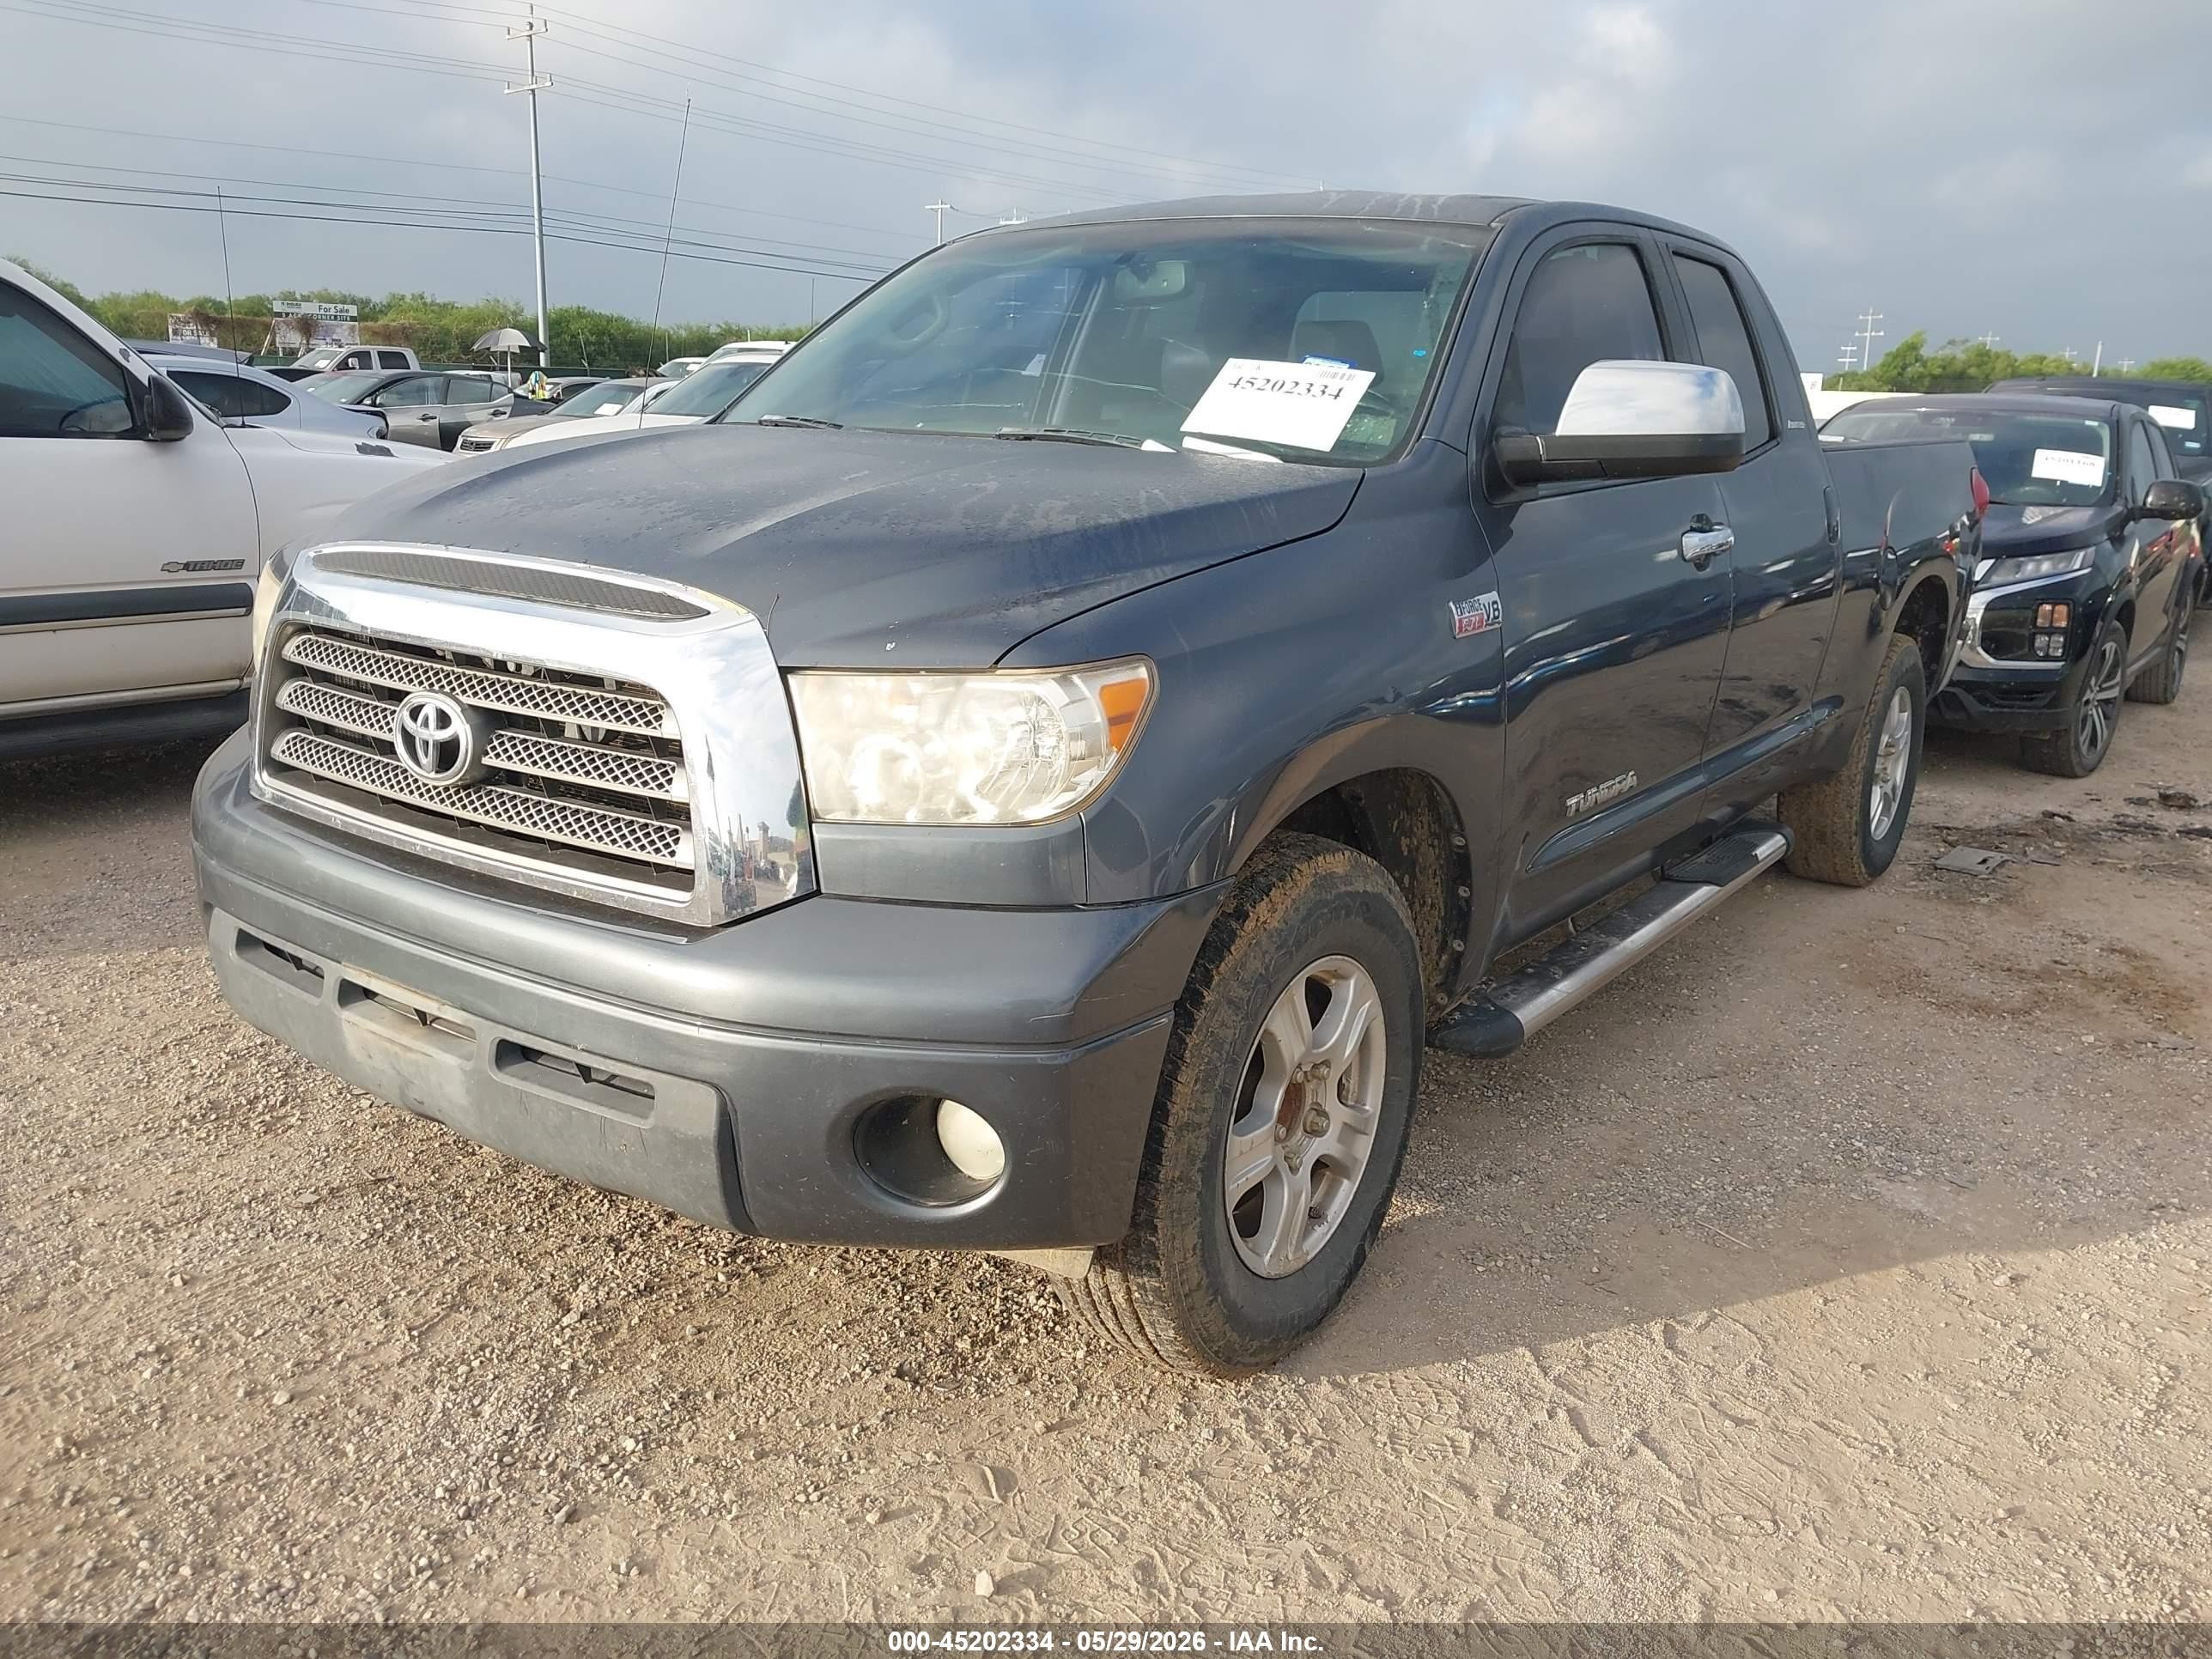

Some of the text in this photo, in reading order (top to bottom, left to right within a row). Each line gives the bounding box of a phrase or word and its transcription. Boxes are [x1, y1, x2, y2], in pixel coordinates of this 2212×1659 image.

[318, 305, 350, 314] For Sale
[1228, 376, 1345, 400] 45202334
[186, 559, 246, 571] TAHOE
[1482, 600, 1500, 622] V8
[1565, 769, 1638, 817] TUNDRA
